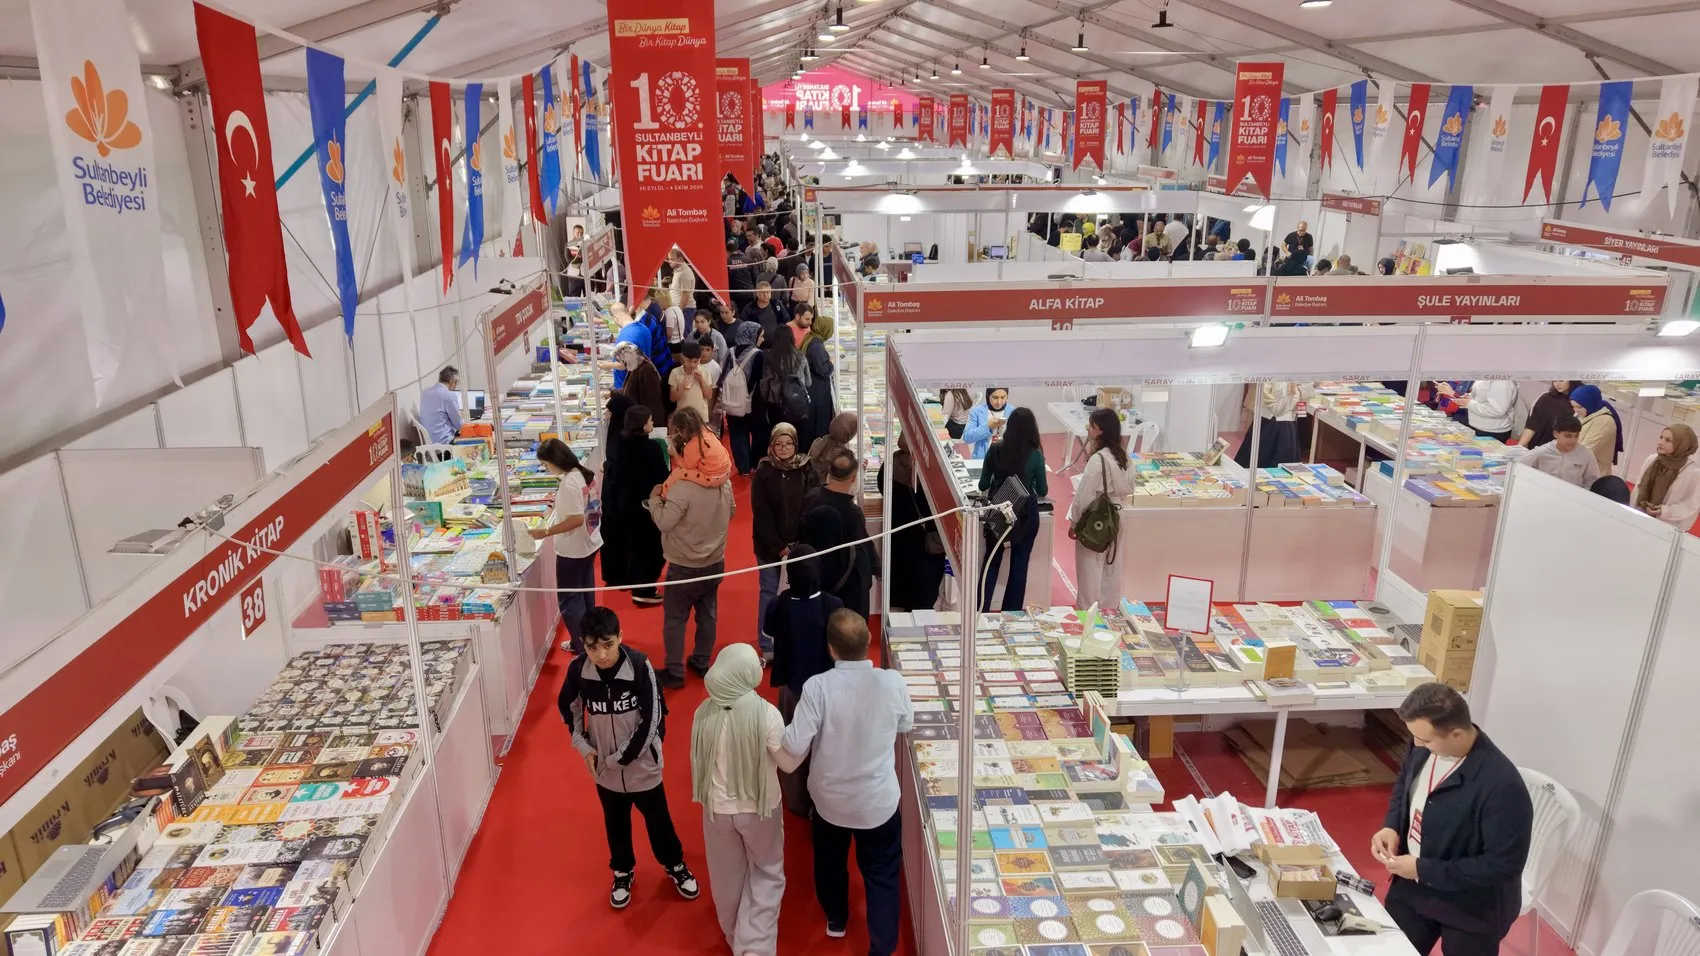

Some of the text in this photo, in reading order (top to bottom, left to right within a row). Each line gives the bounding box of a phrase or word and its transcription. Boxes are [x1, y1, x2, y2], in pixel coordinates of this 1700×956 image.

[618, 21, 686, 34] Bir Dünya Kitap
[639, 35, 708, 48] Bir Kitap Dünya
[718, 124, 742, 133] İTAP
[1238, 127, 1269, 136] KİTAP
[718, 133, 743, 142] UARI
[1237, 136, 1268, 144] FUARI
[72, 156, 148, 191] Sultanbeyli
[637, 163, 703, 182] FUARI
[82, 183, 146, 214] Belediyesi
[666, 208, 708, 217] Ali Tombaş
[1625, 240, 1660, 254] YAYINLARI
[896, 301, 920, 309] Tombaş
[1029, 295, 1105, 311] ALFA KİTAP
[1417, 295, 1521, 309] ŞULE YAYINLARI
[182, 515, 285, 619] KRONİK KİTAP
[242, 586, 264, 629] 38
[83, 748, 118, 788] Kronik
[29, 800, 72, 845] Kronik
